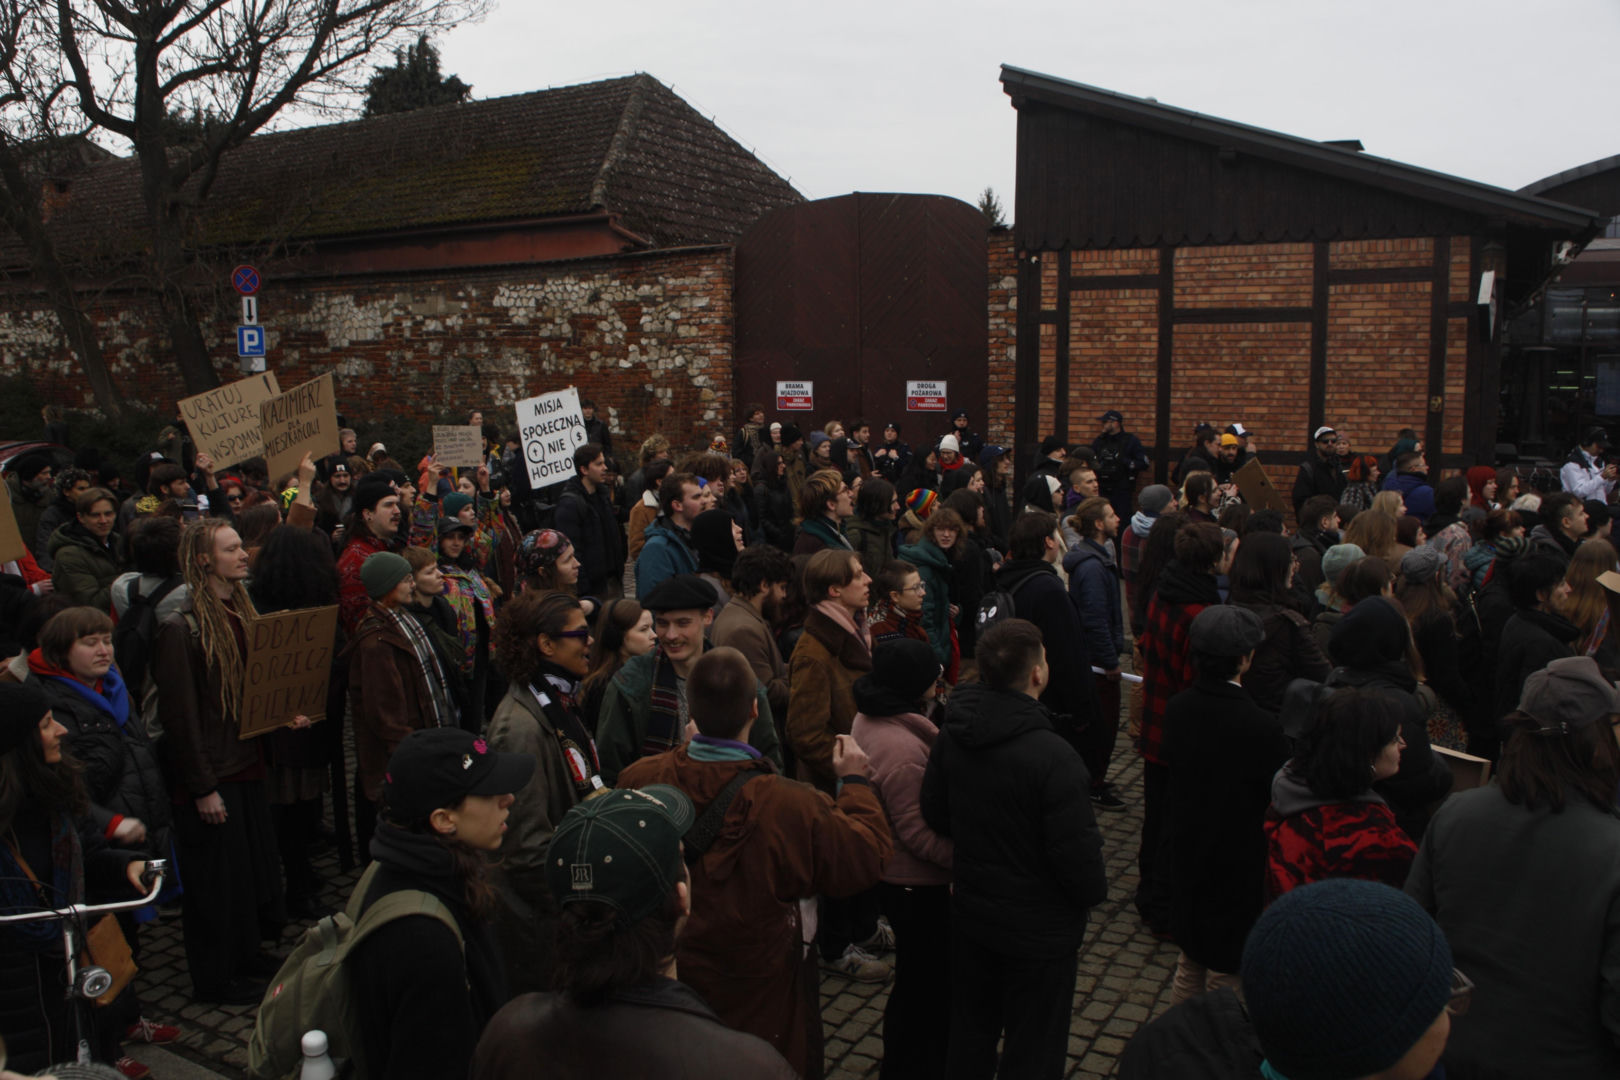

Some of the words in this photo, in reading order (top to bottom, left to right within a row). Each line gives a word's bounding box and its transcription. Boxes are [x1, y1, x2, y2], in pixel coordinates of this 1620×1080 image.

[243, 329, 260, 353] P
[184, 383, 242, 420] URATUJ
[261, 379, 323, 430] KAZIMIERZ
[534, 398, 563, 417] MISJA
[522, 414, 582, 441] SPOŁECZNA
[547, 438, 567, 454] NIE
[531, 456, 574, 481] HOTELO
